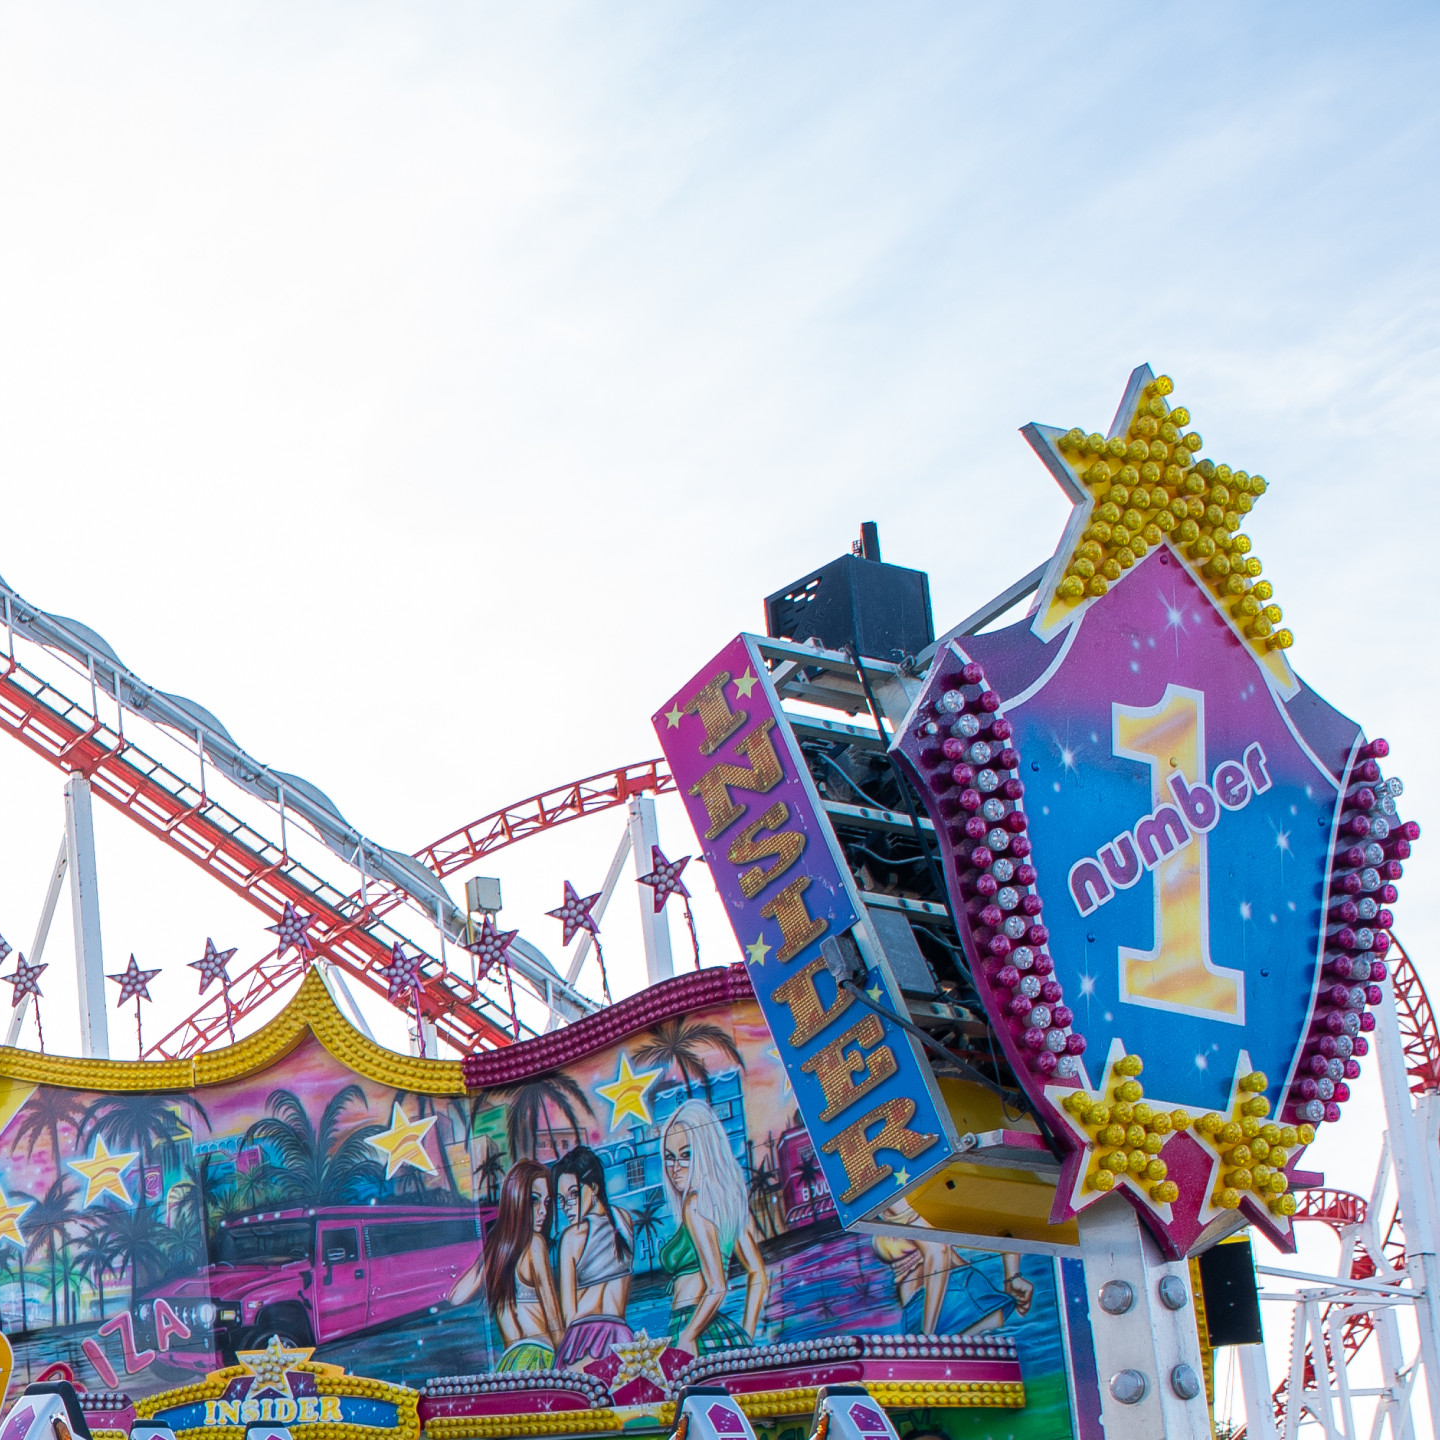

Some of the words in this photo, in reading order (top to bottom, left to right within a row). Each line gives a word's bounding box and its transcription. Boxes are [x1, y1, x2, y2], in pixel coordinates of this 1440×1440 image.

[682, 670, 940, 1204] INSIDER
[1068, 741, 1272, 917] number
[1112, 683, 1246, 1026] 1
[204, 1396, 343, 1425] INSIDER
